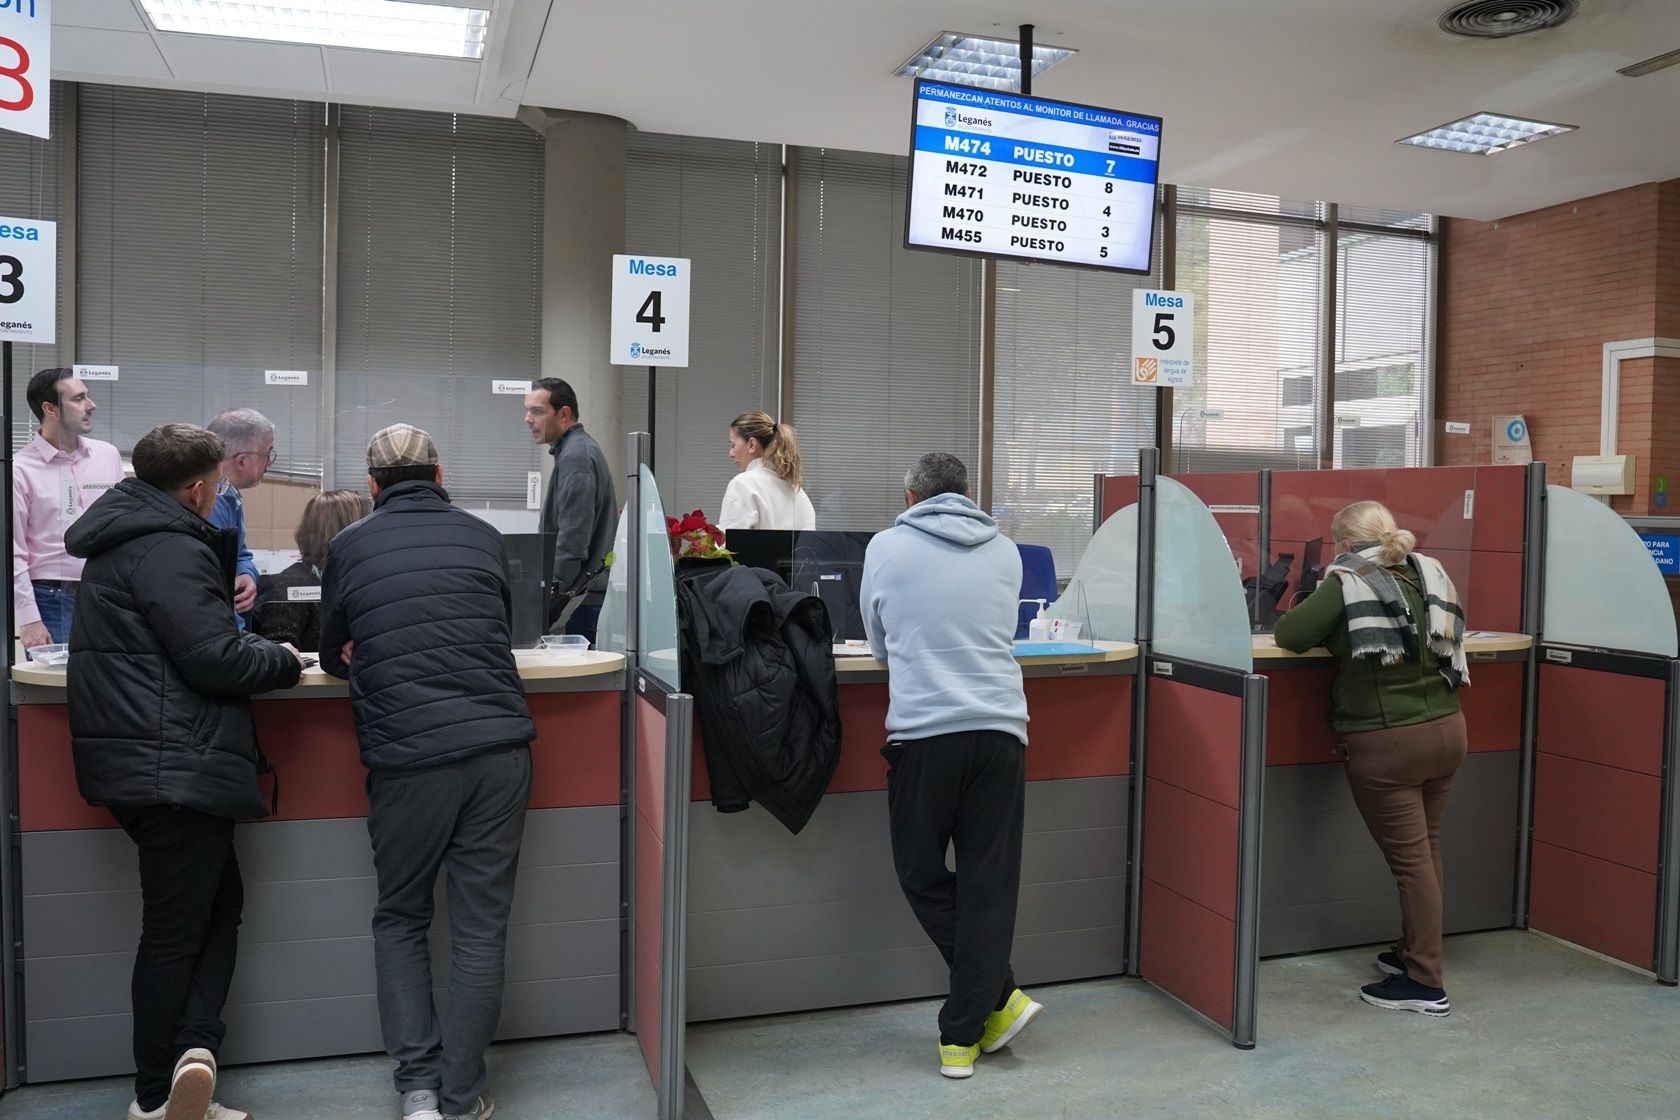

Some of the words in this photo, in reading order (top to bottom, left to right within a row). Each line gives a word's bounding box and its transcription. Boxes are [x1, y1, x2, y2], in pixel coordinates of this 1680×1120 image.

[920, 86, 983, 103] PERMANEZCAN
[984, 97, 1022, 109] ATENTOS
[1023, 104, 1034, 112] AL
[1035, 105, 1072, 118] MONITOR
[1073, 110, 1084, 120] DE
[1085, 113, 1124, 127] LLAMADA.
[1126, 120, 1160, 132] GRACIAS
[958, 114, 993, 127] Leganés
[944, 135, 992, 156] M474
[1013, 146, 1075, 167] PUESTO
[1105, 159, 1116, 174] 7
[946, 160, 988, 178] M472
[1013, 170, 1072, 189] PUESTO
[1104, 182, 1113, 194] 8
[944, 183, 984, 200] M471
[1012, 192, 1070, 211] PUESTO
[1102, 205, 1112, 218] 4
[942, 206, 984, 222] M470
[1011, 214, 1067, 232] PUESTO
[1101, 226, 1110, 238] 3
[941, 227, 982, 243] M455
[1010, 235, 1065, 252] PUESTO
[1099, 247, 1109, 258] 5
[0, 255, 25, 304] 3
[629, 259, 677, 277] Mesa
[635, 290, 666, 333] 4
[1145, 292, 1184, 308] Mesa
[1152, 312, 1176, 351] 5
[641, 347, 671, 355] Leganés
